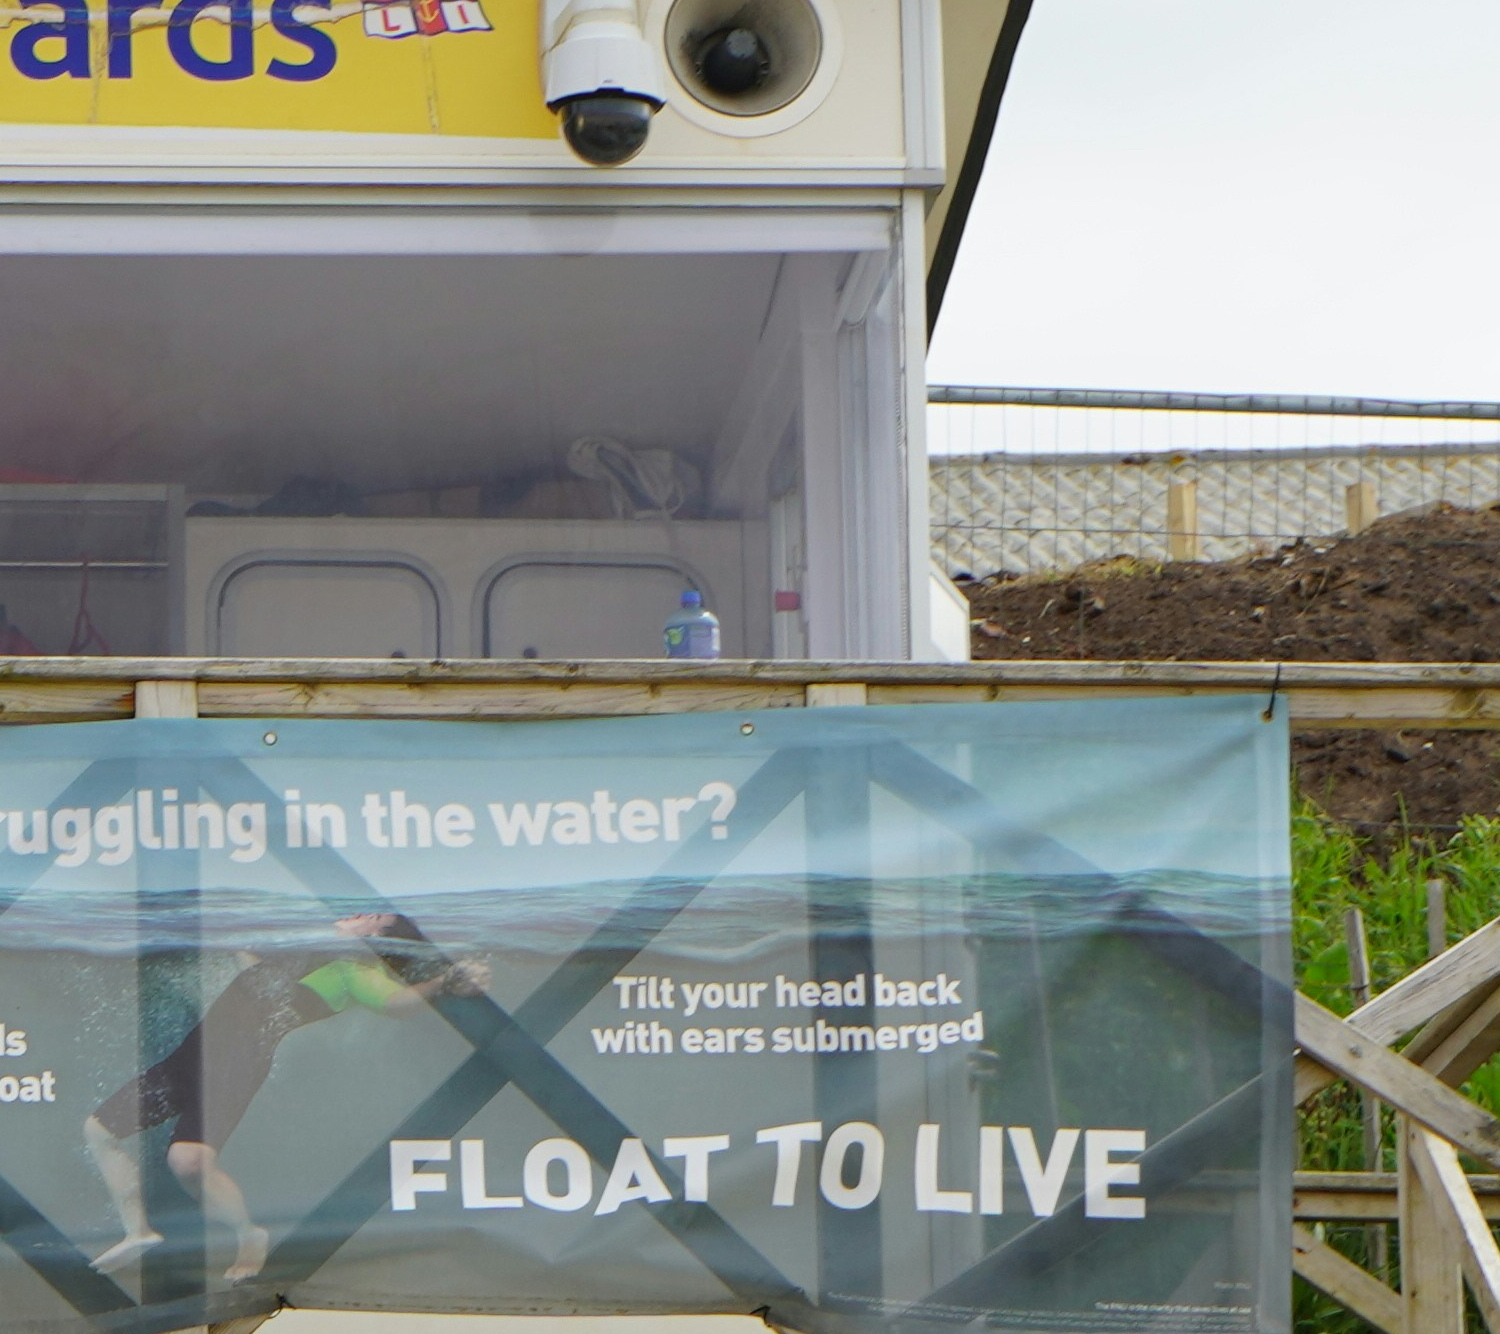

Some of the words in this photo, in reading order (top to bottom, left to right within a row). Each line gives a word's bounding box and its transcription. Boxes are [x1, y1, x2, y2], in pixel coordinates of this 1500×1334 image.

[285, 789, 348, 848] in
[362, 790, 475, 848] the
[488, 782, 736, 847] water?
[613, 976, 675, 1009] Tilt
[681, 983, 768, 1016] your
[775, 973, 866, 1008] head
[874, 973, 962, 1007] back
[591, 1021, 673, 1054] with
[680, 1028, 765, 1054] ears
[771, 1011, 984, 1054] submerged
[390, 1134, 730, 1215] FLOAT
[756, 1121, 885, 1209] TO
[915, 1124, 1146, 1218] LIVE
